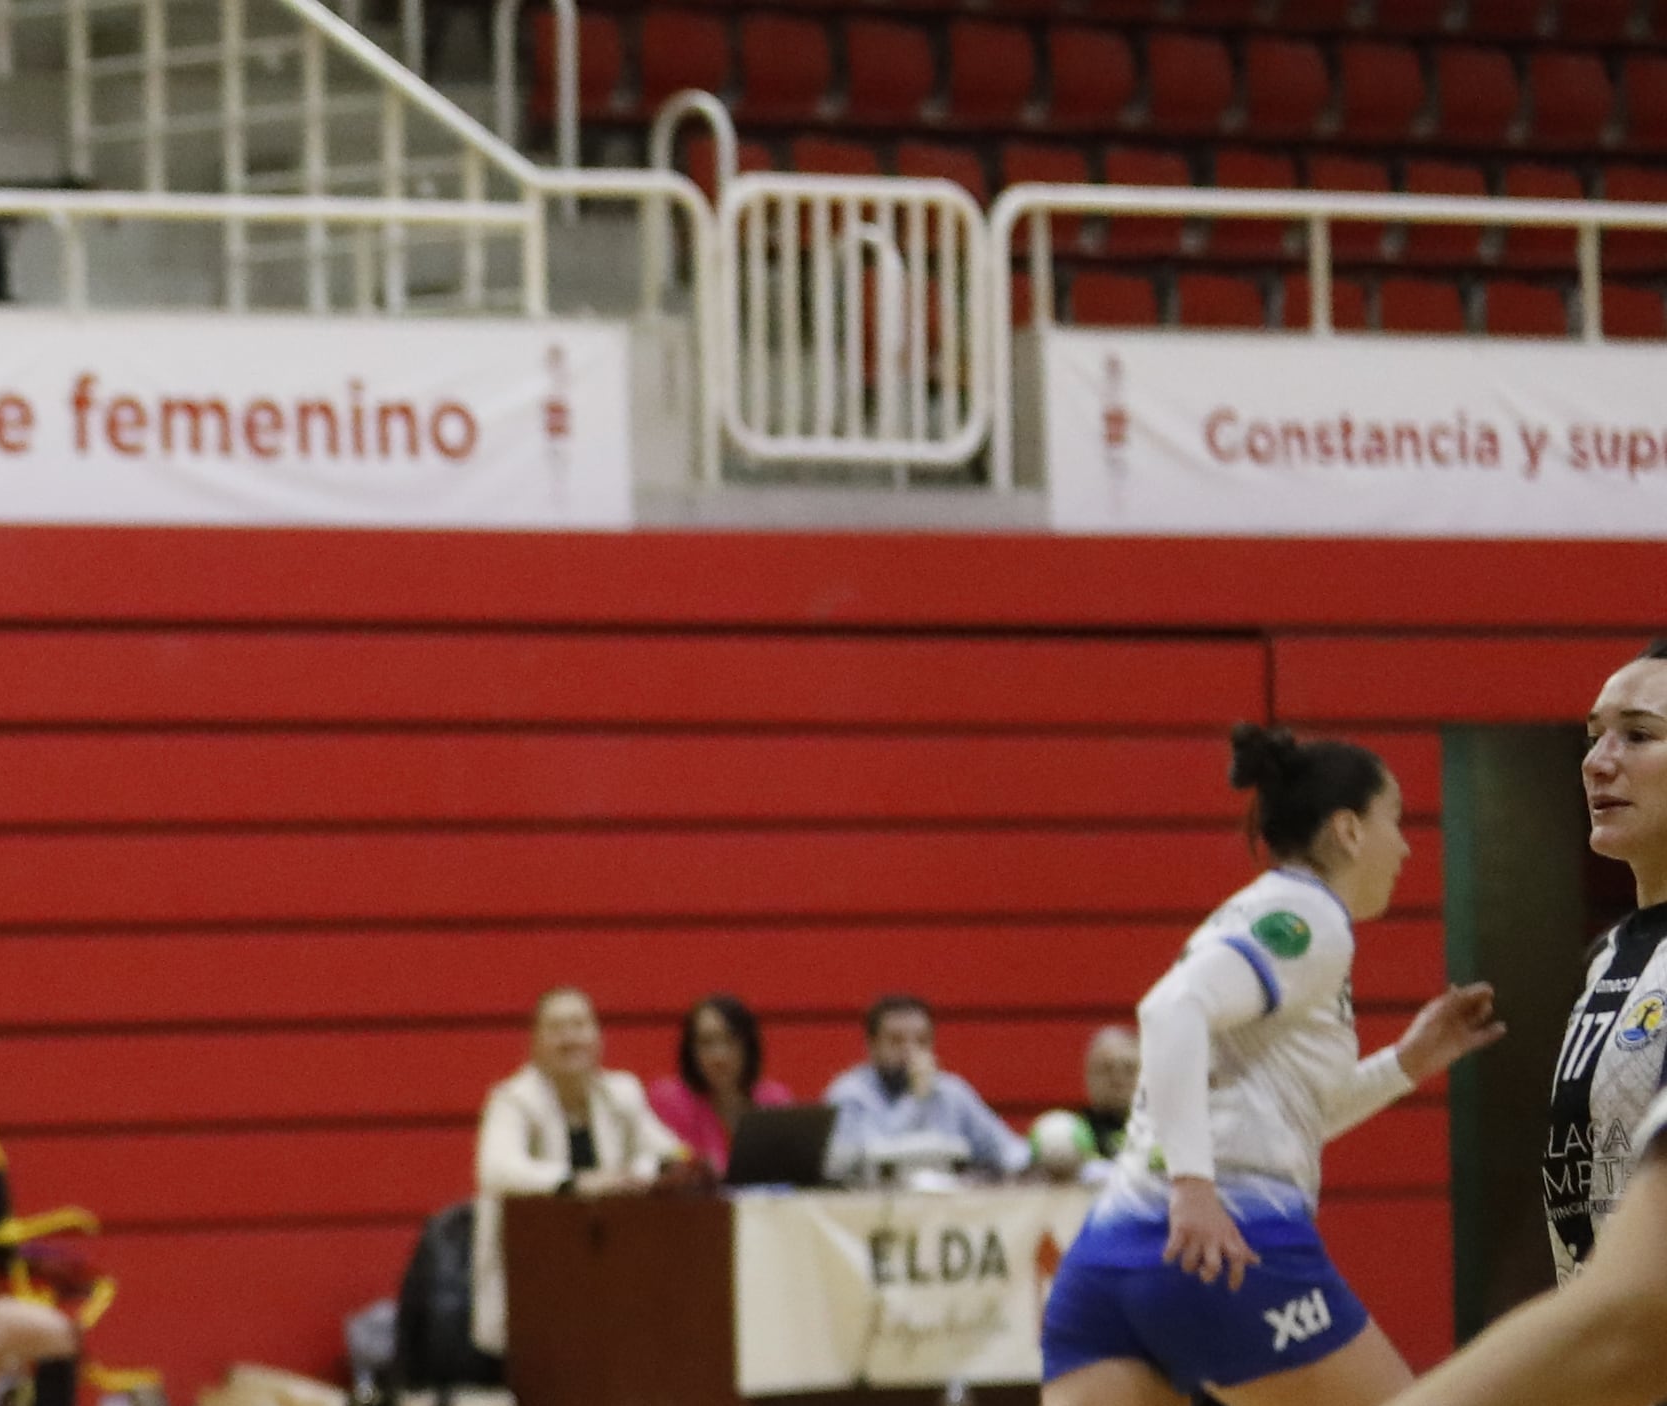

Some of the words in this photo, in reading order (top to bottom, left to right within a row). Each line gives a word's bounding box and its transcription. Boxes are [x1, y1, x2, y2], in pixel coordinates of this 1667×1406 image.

[69, 372, 479, 462] femenino
[1204, 406, 1501, 466] Constancia
[1518, 422, 1549, 479] y
[1569, 424, 1667, 480] sup
[1544, 1119, 1631, 1158] LAGA
[869, 1227, 1009, 1285] ELDA
